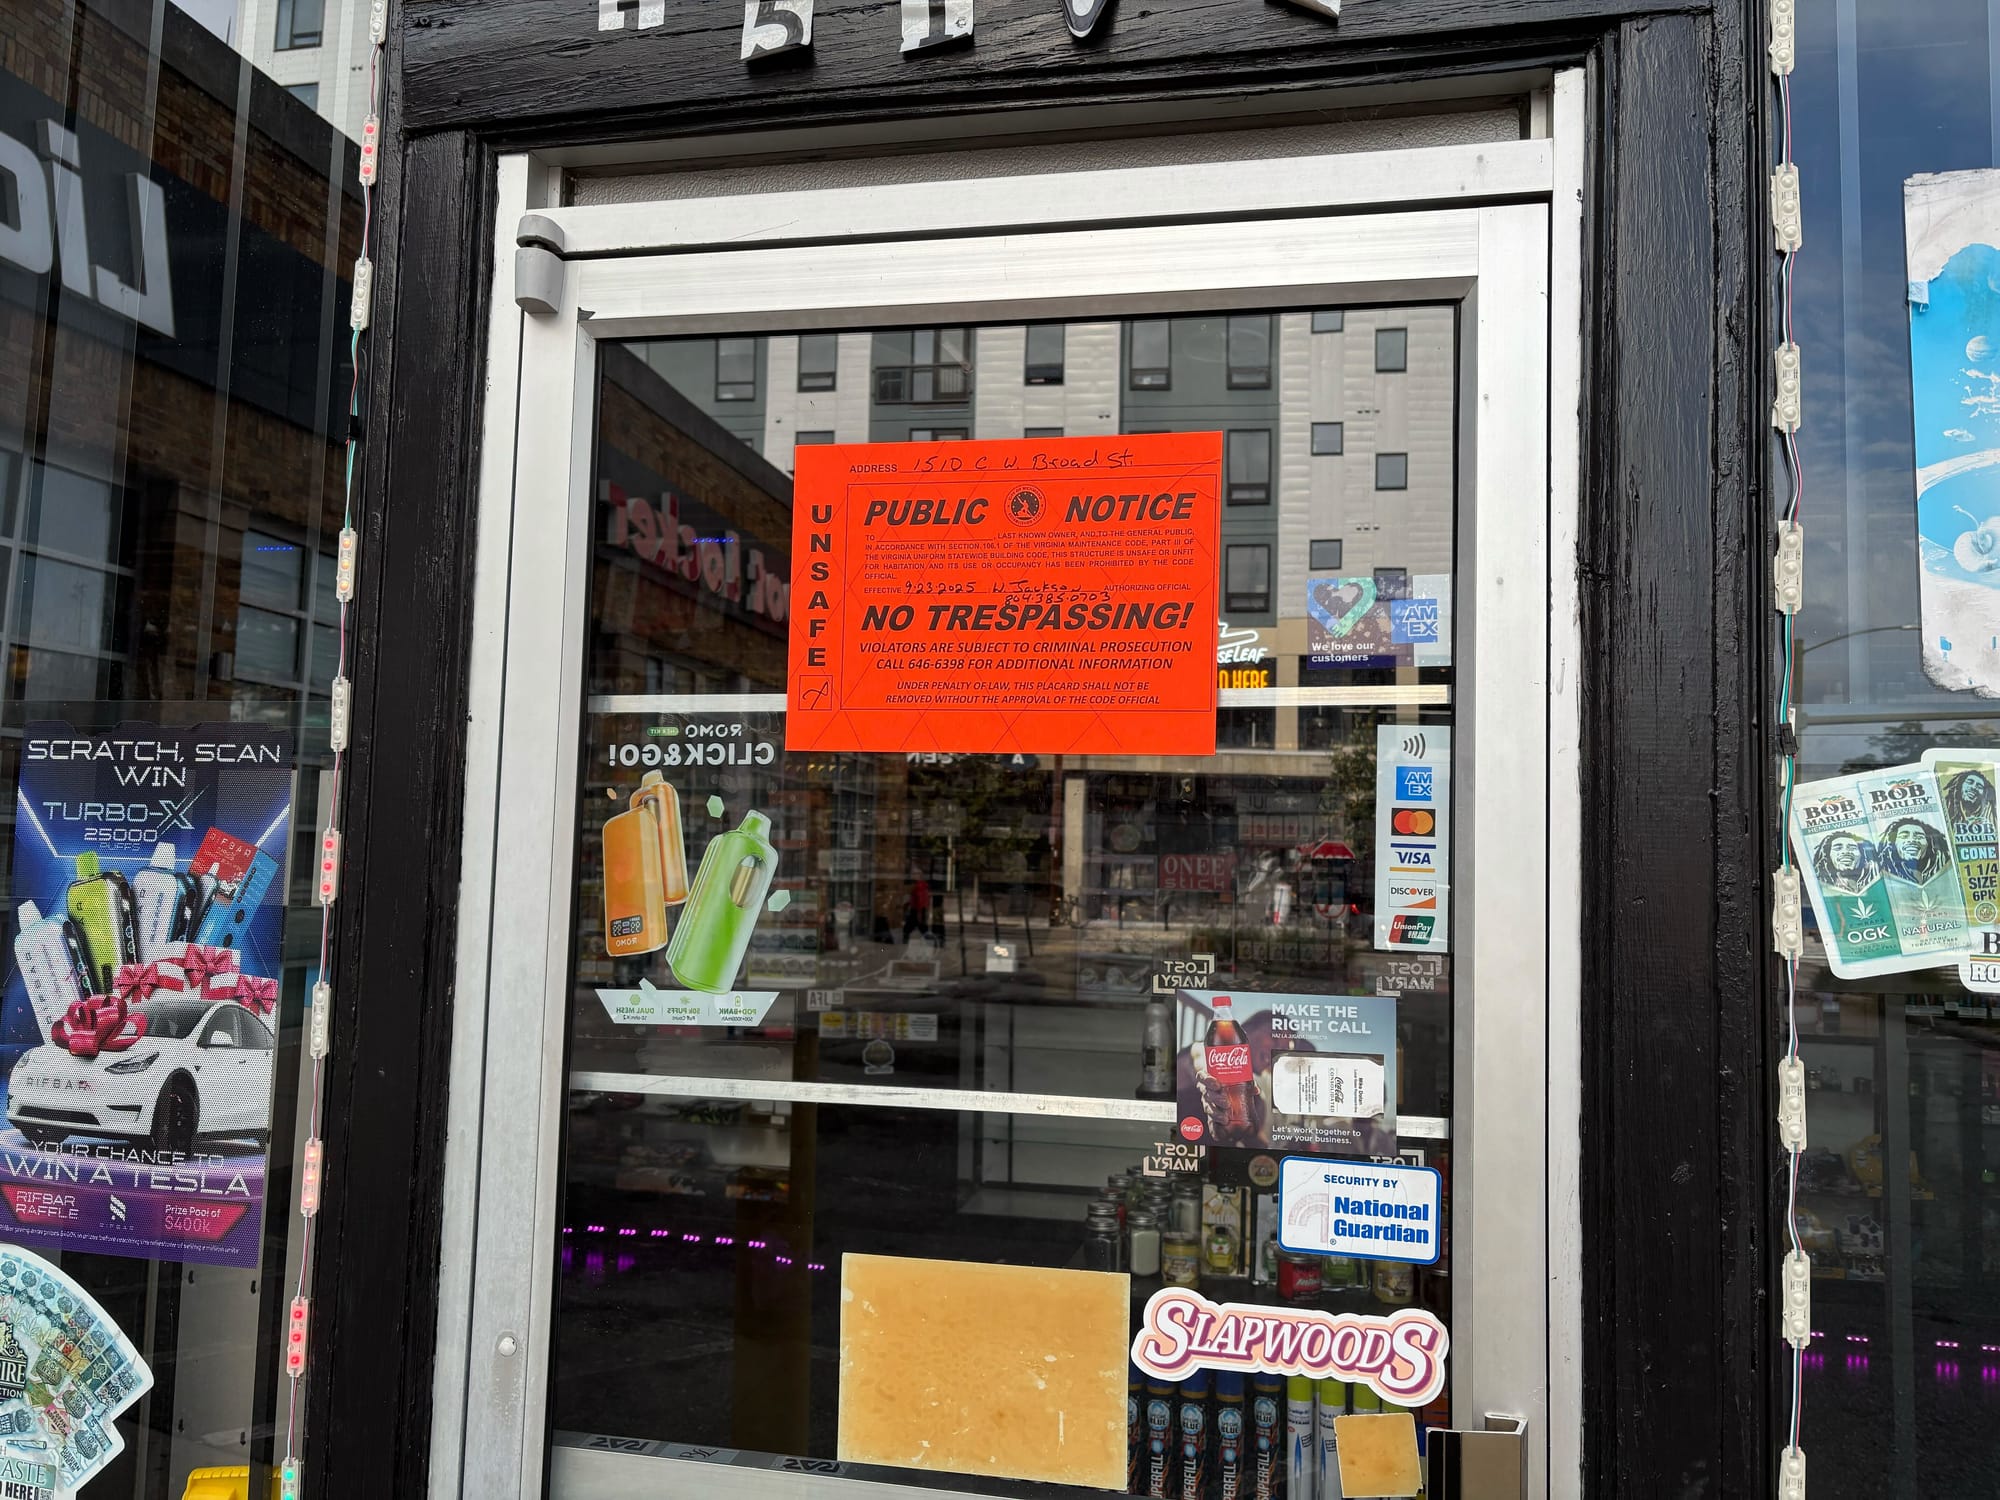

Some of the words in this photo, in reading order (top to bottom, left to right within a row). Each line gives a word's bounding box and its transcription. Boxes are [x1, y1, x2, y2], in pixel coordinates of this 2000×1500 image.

[850, 464, 898, 473] ADDRESS
[914, 456, 963, 473] 1510
[975, 456, 988, 469] C
[1032, 450, 1099, 470] Broad
[864, 498, 989, 526] PUBLIC
[1065, 493, 1197, 523] NOTICE
[1049, 531, 1077, 540] OWNER,
[1165, 528, 1195, 536] PUBLIC,
[875, 543, 925, 551] ACCORDANCE
[1068, 540, 1121, 548] MAINTENANCE
[808, 504, 832, 667] UNSAFE
[1009, 579, 1082, 593] Jackson
[1104, 584, 1154, 592] AUTHORIZING
[1157, 583, 1191, 591] OFFICIAL
[861, 605, 915, 631] NO
[928, 602, 1195, 631] TRESPASSING!
[1404, 605, 1438, 622] AM
[860, 642, 926, 653] VIOLATORS
[929, 642, 954, 653] ARE
[957, 642, 1009, 653] SUBJECT
[1014, 642, 1029, 653] TO
[1033, 642, 1096, 653] CRIMINAL
[1100, 641, 1193, 652] PROSECUTION
[1312, 642, 1329, 651] We
[1330, 641, 1353, 651] love
[1356, 642, 1375, 651] our
[876, 658, 904, 669] CALL
[908, 658, 964, 669] 646-6398
[967, 658, 993, 669] FOR
[996, 658, 1075, 669] ADDITIONAL
[1078, 658, 1173, 669] INFORMATION
[1312, 654, 1369, 663] customers
[897, 682, 929, 690] UNDER
[931, 682, 971, 690] PENALTY
[973, 682, 986, 690] OF
[988, 682, 1011, 691] LAW,
[1014, 682, 1034, 690] THIS
[1037, 682, 1080, 690] PLACARD
[1082, 682, 1111, 690] SHALL
[1113, 682, 1135, 690] NOT
[1137, 682, 1149, 690] BE
[886, 695, 932, 703] REMOVED
[935, 695, 978, 703] WITHOUT
[981, 695, 999, 703] THE
[1002, 695, 1050, 704] APPROVAL
[1053, 695, 1066, 704] OF
[1069, 695, 1087, 704] THE
[1090, 695, 1116, 704] CODE
[1117, 695, 1160, 704] OFFICIAL
[28, 740, 185, 763] SCRATCH,
[195, 743, 280, 763] SCAN
[114, 766, 187, 787] WIN
[1405, 771, 1433, 784] AM
[1869, 784, 1926, 804] BOB
[1804, 799, 1856, 820] BOB
[1872, 797, 1930, 813] MARLEY
[43, 798, 197, 830] TURBO-X
[1805, 811, 1860, 828] MARLEY
[84, 828, 158, 842] 25000
[1955, 822, 1995, 835] BOB
[1955, 834, 1999, 843] MARLEY
[1395, 851, 1432, 865] VISA
[1961, 847, 1997, 859] CONE
[1964, 865, 1971, 876] 1
[1976, 863, 1999, 876] 1/4
[1968, 876, 1997, 889] SIZE
[1390, 886, 1434, 897] DISCOVER
[1972, 891, 1997, 902] 6PK
[1393, 921, 1432, 935] UnionPay
[1847, 925, 1891, 943] OGK
[1903, 920, 1962, 936] NATURAL
[1272, 1003, 1320, 1016] MAKE
[1324, 1005, 1358, 1018] THE
[1272, 1018, 1323, 1032] RIGHT
[1327, 1020, 1371, 1034] CALL
[1293, 1126, 1313, 1134] work
[1315, 1128, 1350, 1138] together
[1315, 1136, 1352, 1144] business.
[30, 1140, 90, 1158] YOUR
[96, 1146, 186, 1166] CHANCE
[194, 1153, 224, 1168] TO
[5, 1154, 79, 1183] WIN
[89, 1163, 115, 1186] A
[129, 1167, 251, 1197] TESLA
[1324, 1174, 1380, 1188] SECURITY
[1383, 1178, 1398, 1189] BY
[15, 1204, 79, 1220] RAFFLE
[165, 1204, 188, 1216] Prize
[189, 1206, 209, 1217] Pool
[210, 1207, 222, 1218] of
[1334, 1196, 1429, 1221] National
[165, 1215, 211, 1233] $400k
[1334, 1218, 1429, 1244] Guardian
[1143, 1297, 1439, 1395] SLAPWOODS
